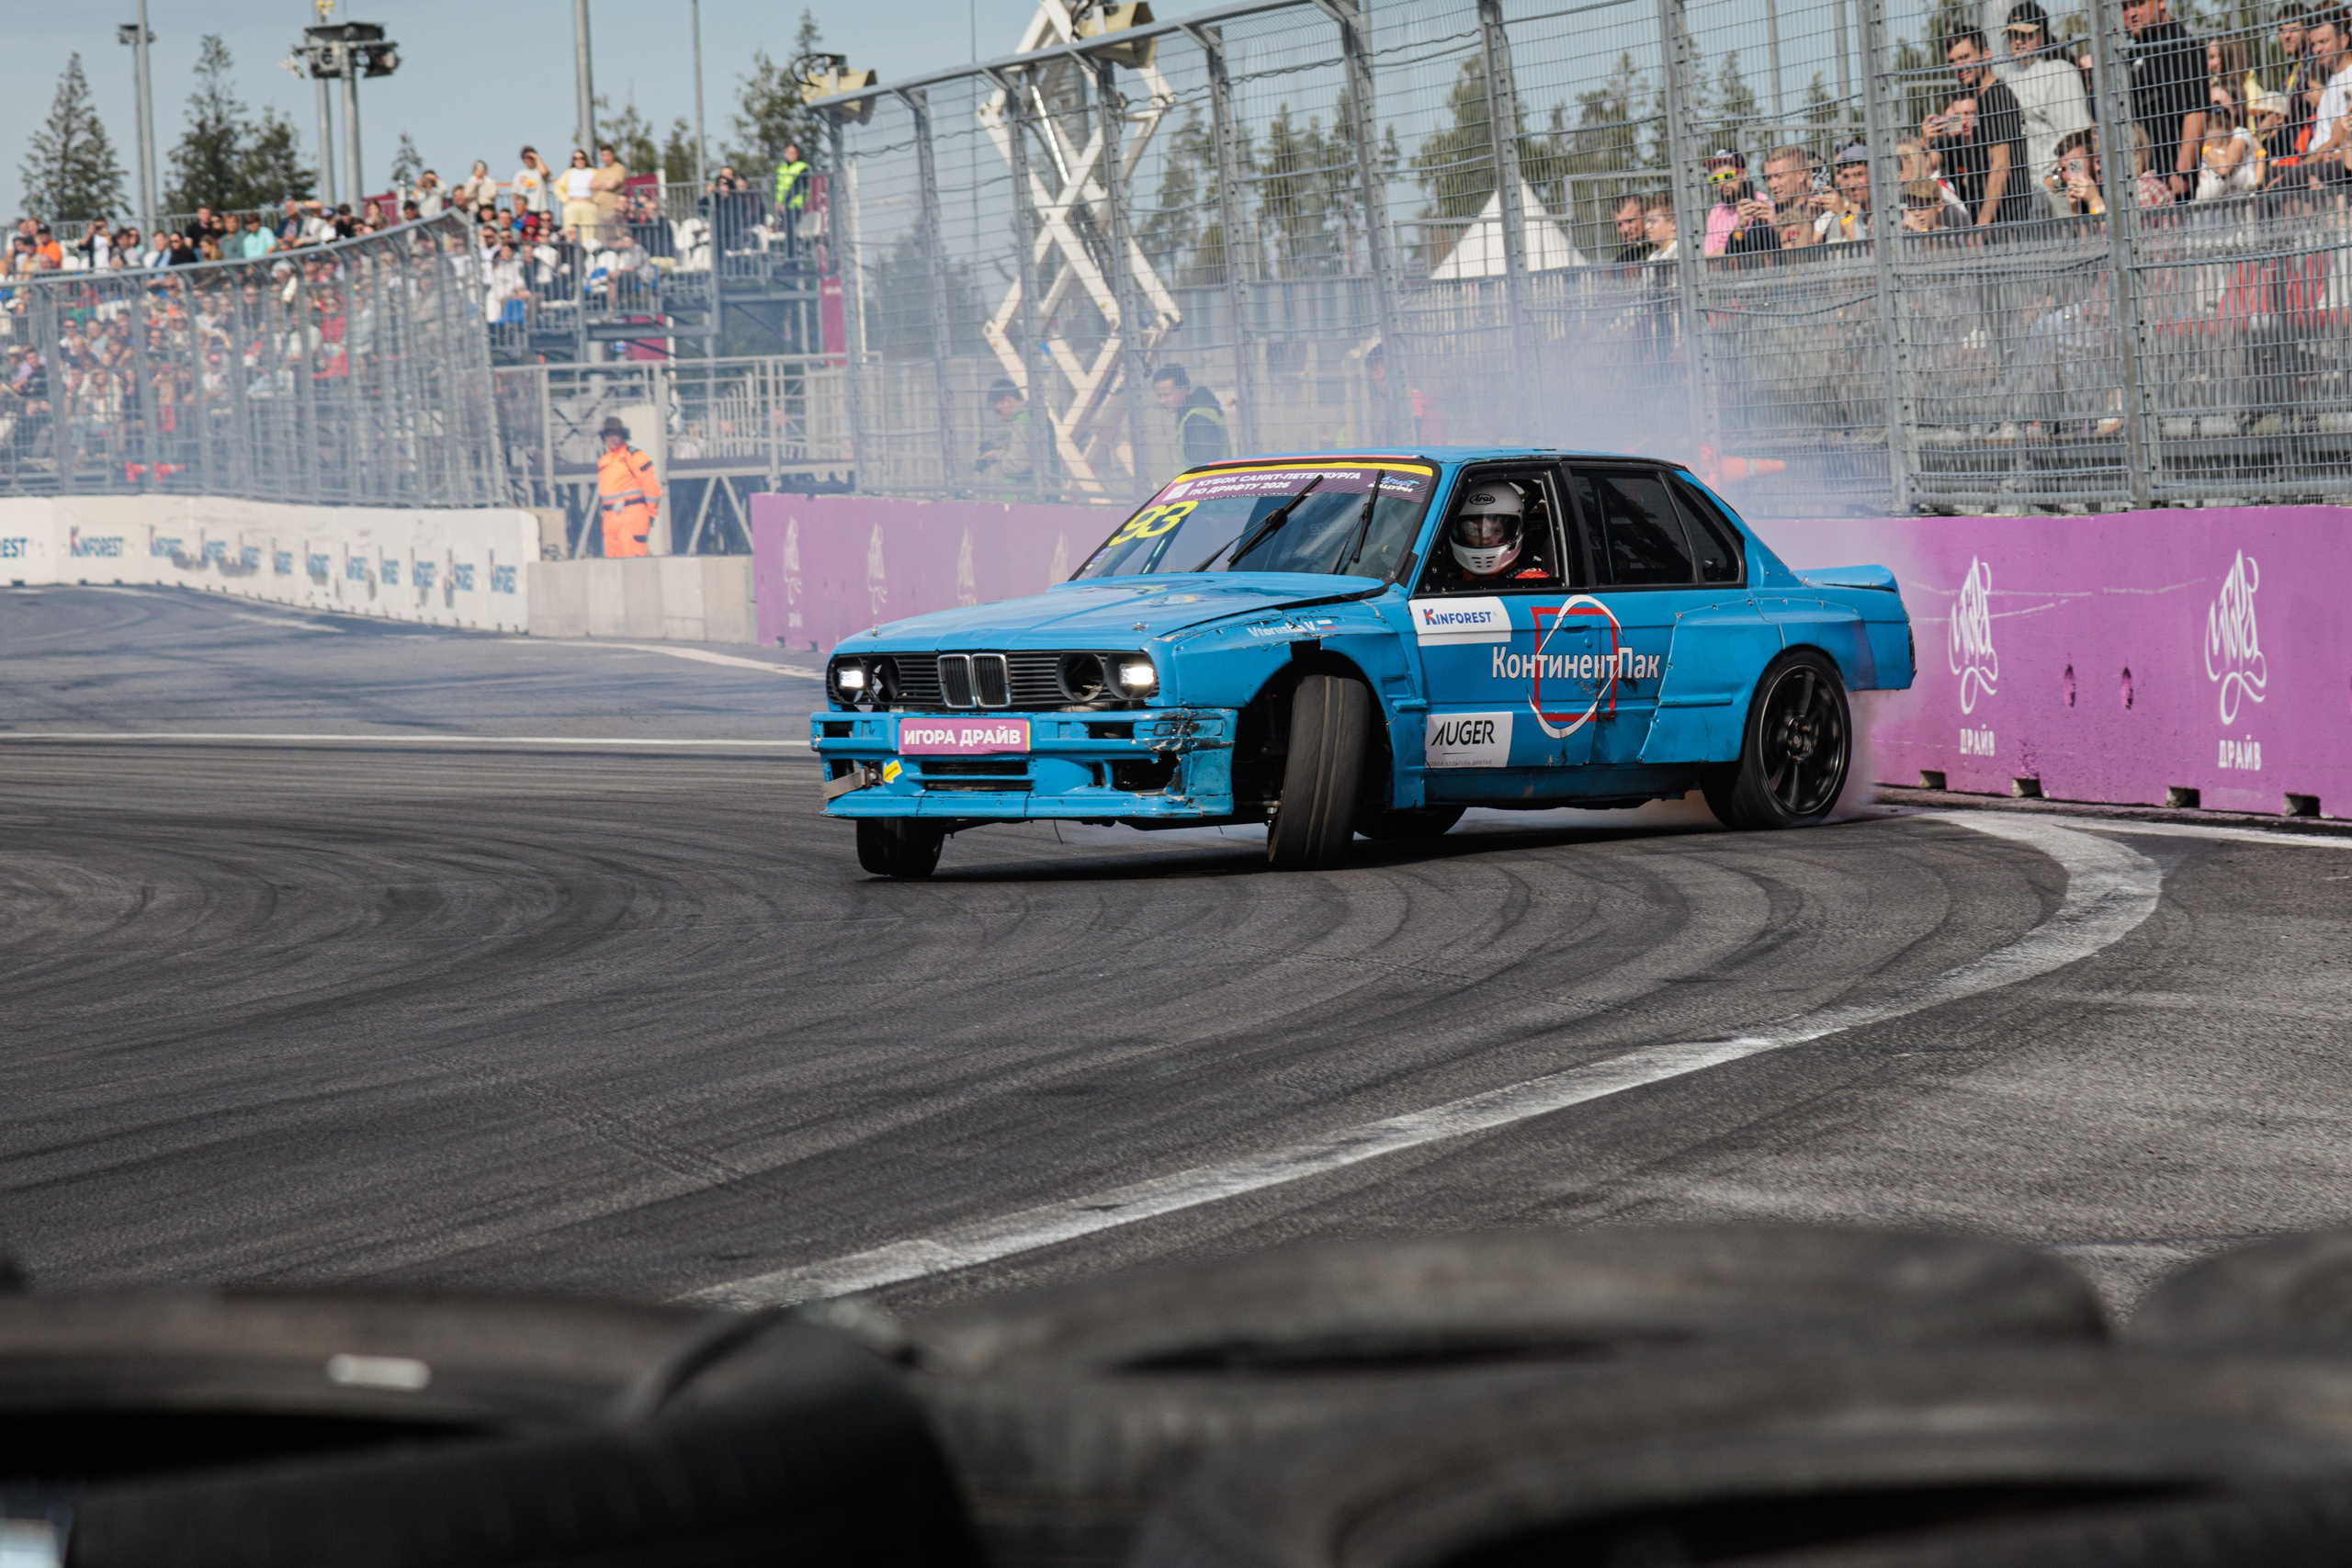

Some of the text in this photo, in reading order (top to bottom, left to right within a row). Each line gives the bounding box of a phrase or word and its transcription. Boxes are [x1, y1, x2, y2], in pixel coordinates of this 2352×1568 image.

[1187, 481, 1292, 496] ПО ДРИФТУ 2026
[1196, 471, 1362, 487] КУБОК САНКТ-ПЕТЕРБУРГА
[1108, 500, 1199, 547] 93
[1304, 620, 1321, 632] V.
[1422, 608, 1492, 626] KINFOREST
[1492, 646, 1660, 680] КонтинентПак
[904, 725, 1022, 747] ИГОРА ДРАЙВ
[1430, 719, 1496, 747] AUGER
[1959, 723, 1996, 757] ДРАЙВ
[2217, 734, 2262, 772] ДРАЙВ
